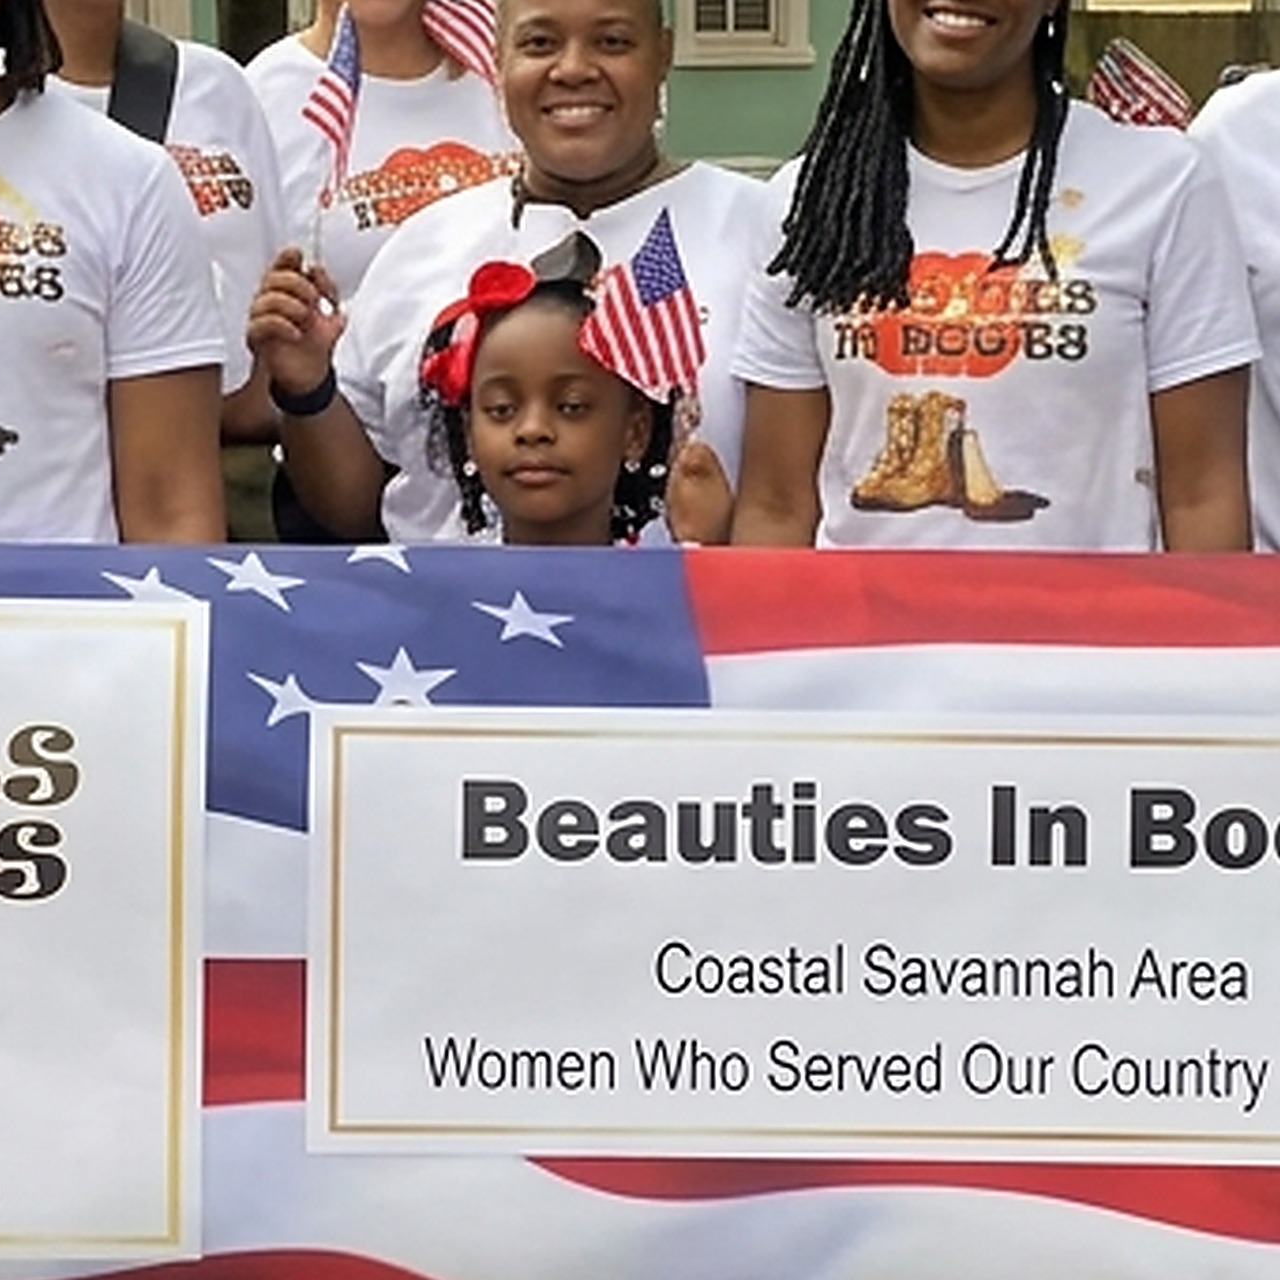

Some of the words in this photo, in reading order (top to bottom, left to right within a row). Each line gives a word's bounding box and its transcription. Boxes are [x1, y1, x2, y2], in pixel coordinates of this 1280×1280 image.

[461, 779, 954, 867] Beauties
[990, 784, 1088, 868] In
[655, 941, 844, 996] Coastal
[863, 942, 1115, 999] Savannah
[1129, 947, 1248, 1002] Area
[424, 1036, 616, 1092] Women
[634, 1038, 750, 1092] Who
[767, 1039, 943, 1095] Served
[961, 1041, 1055, 1096] Our
[1072, 1042, 1269, 1113] Country
